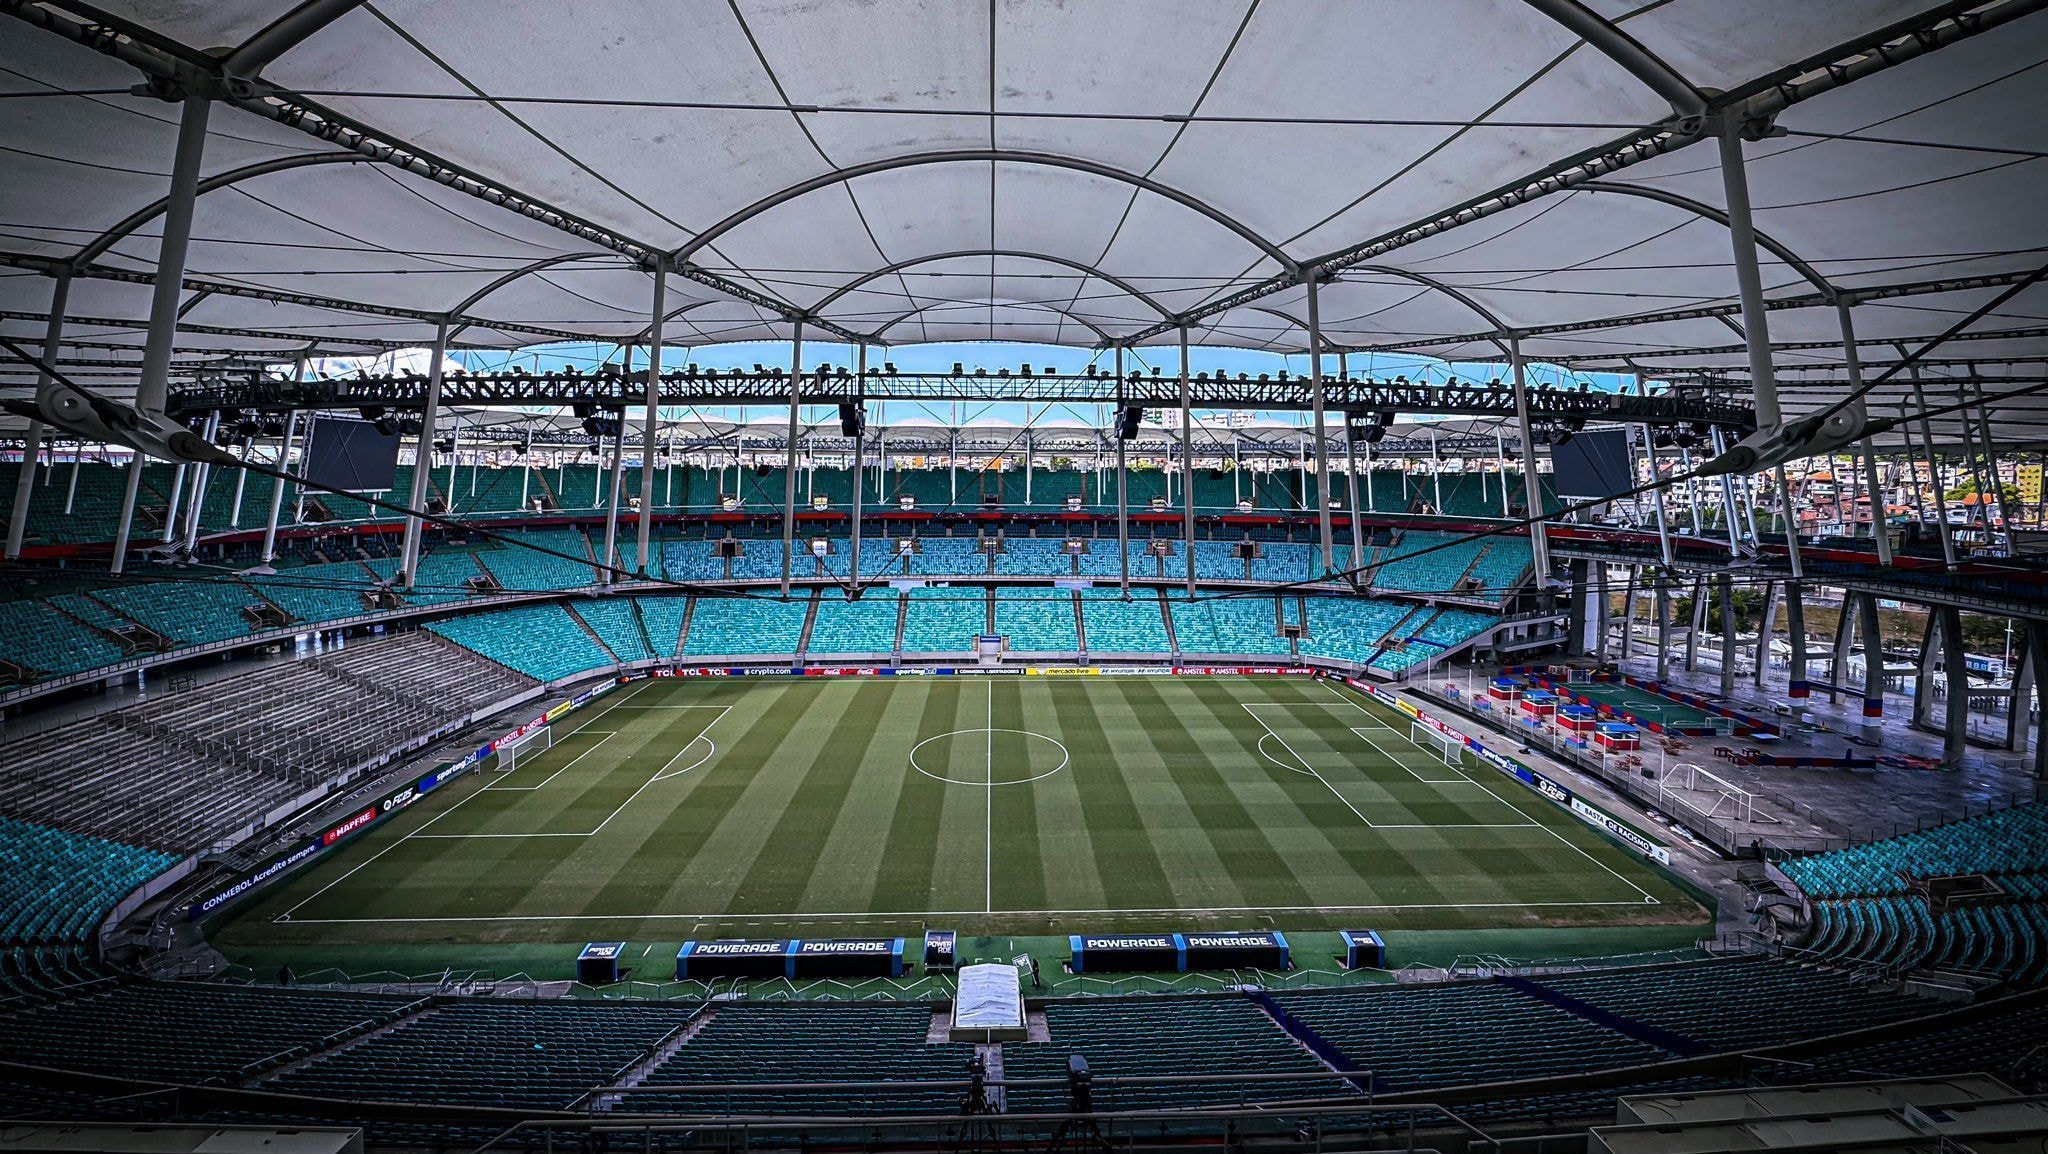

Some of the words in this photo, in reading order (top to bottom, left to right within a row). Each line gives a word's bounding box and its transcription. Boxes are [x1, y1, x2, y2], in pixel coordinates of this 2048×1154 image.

[681, 668, 702, 676] TCL
[707, 668, 728, 676] TCL
[750, 668, 791, 676] crypto.com
[1183, 667, 1206, 675] AMSTEL
[1216, 667, 1240, 675] AMSTEL
[527, 717, 543, 731] AMSTEL
[500, 730, 519, 746] AMSTEL
[1447, 727, 1466, 743] AMSTEL
[336, 811, 371, 837] MAPFRE
[1584, 806, 1605, 824] BASTA
[1608, 821, 1618, 832] DE
[1618, 827, 1650, 850] RACISMO
[203, 879, 253, 911] CONMEBOL
[253, 860, 287, 884] Acredite
[287, 844, 315, 865] sempre
